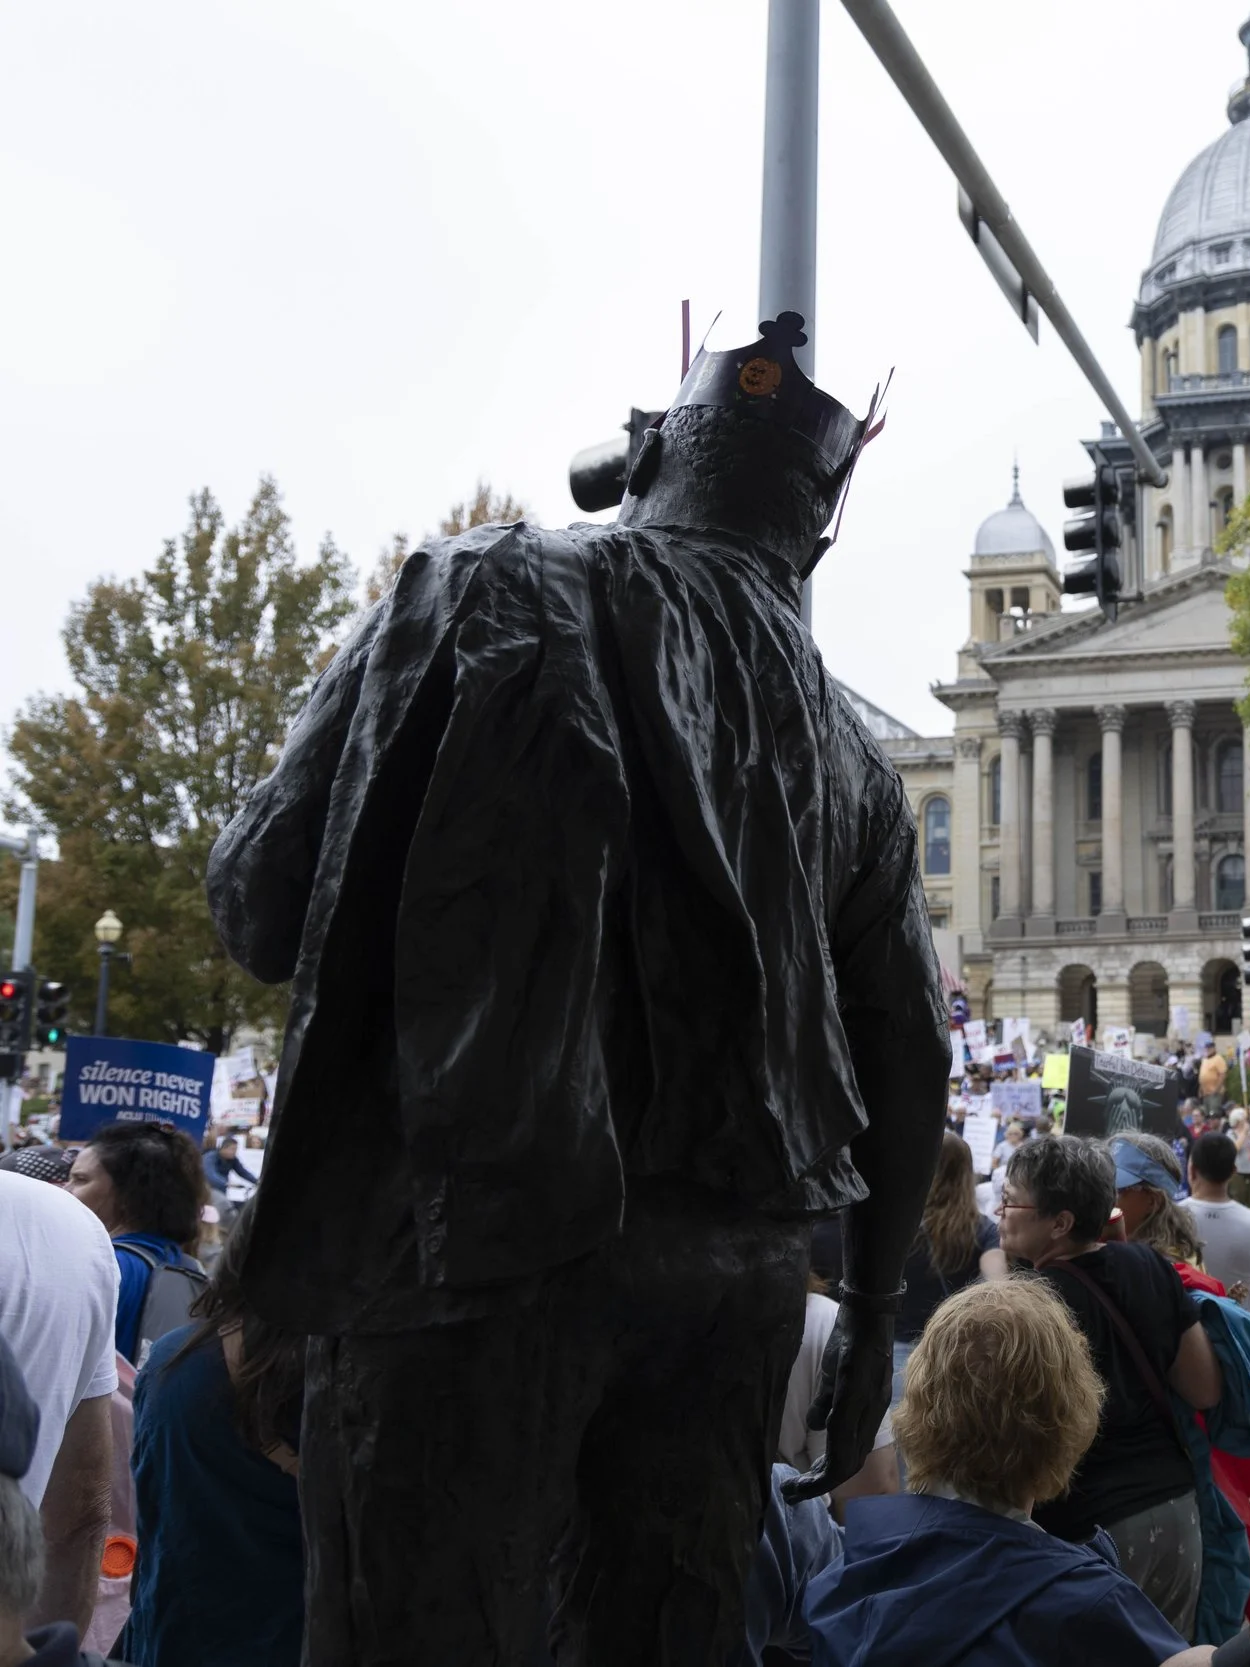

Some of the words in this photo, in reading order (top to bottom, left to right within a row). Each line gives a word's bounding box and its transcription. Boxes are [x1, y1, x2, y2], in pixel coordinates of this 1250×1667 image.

[79, 1060, 153, 1085] silence
[154, 1071, 204, 1096] never
[79, 1083, 136, 1106] WON
[139, 1087, 202, 1119] RIGHTS
[115, 1110, 144, 1120] ACLU
